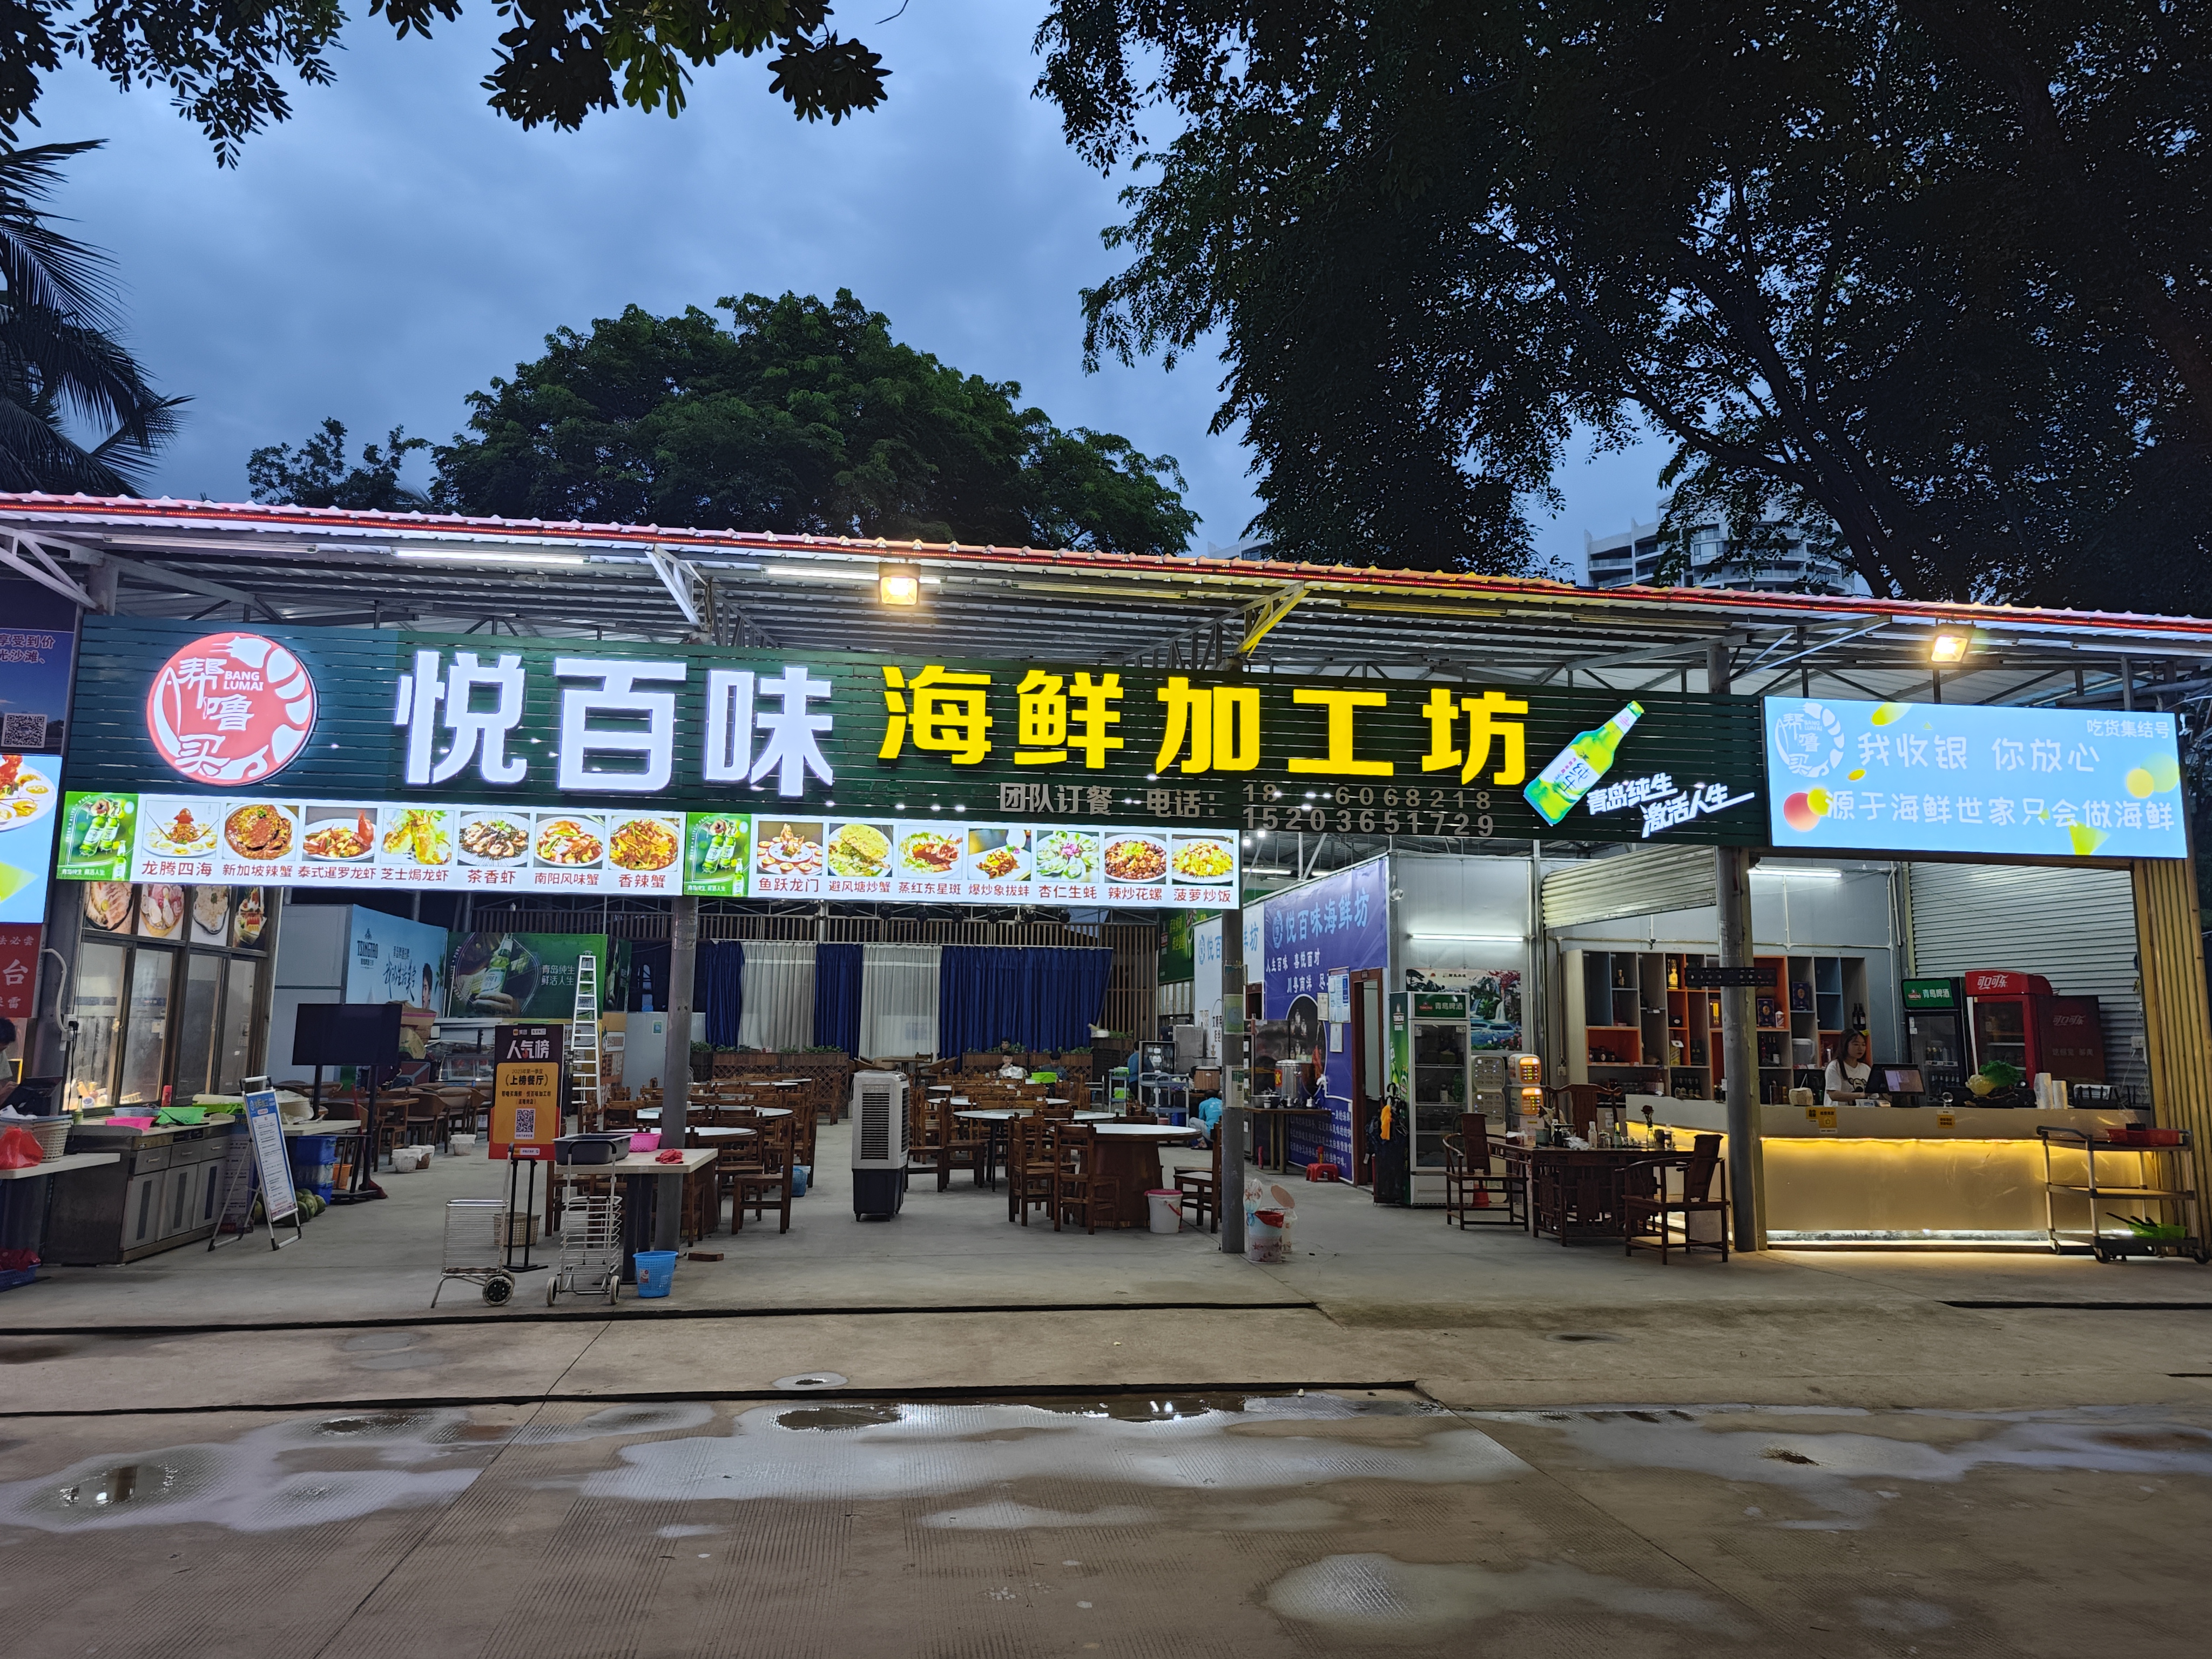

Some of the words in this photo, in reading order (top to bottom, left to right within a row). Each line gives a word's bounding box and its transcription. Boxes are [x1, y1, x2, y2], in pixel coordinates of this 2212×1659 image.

[224, 670, 260, 682] BANG
[223, 680, 264, 691] LUMAI
[394, 651, 833, 797] 悦百味
[878, 665, 1528, 786] 海鲜加工坊
[2086, 718, 2170, 739] 吃货集结号
[1856, 730, 1967, 770] 我收银
[1991, 736, 2101, 773] 你放心
[999, 783, 1114, 815] 团队订餐
[1586, 773, 1678, 816] 青岛纯生
[1639, 783, 1755, 839] 激活人生
[1825, 790, 2175, 832] 源于海鲜世家只会做海鲜
[1242, 807, 1494, 837] 15203651729
[141, 860, 213, 876] 龙腾四海
[222, 864, 293, 878] 新加坡辣蟹
[298, 865, 377, 880] 泰式暹罗龙虾
[380, 867, 449, 882] 芝士焗龙虾
[467, 868, 516, 885] 茶香虾
[535, 873, 599, 886] 南阳风味蟹
[618, 874, 666, 888] 香辣蟹
[758, 877, 819, 893] 鱼跃龙门
[828, 880, 891, 893] 避风塘炒蟹
[898, 881, 962, 895] 蒸红东星斑
[968, 884, 1030, 896] 爆炒象拔蚌
[1038, 885, 1097, 899] 杏仁生蚝
[1107, 887, 1163, 901] 辣炒花螺
[1173, 888, 1231, 903] 菠萝炒饭
[1286, 887, 1370, 944] 悦百味海鲜坊
[357, 940, 379, 959] TSINGTAO
[1266, 954, 1288, 973] 人生百味
[1293, 947, 1320, 969] 喜悦面对
[3, 959, 29, 986] 台
[542, 965, 576, 975] 青岛纯生
[541, 975, 575, 986] 鲜活人生
[1977, 974, 2008, 990] 可口可乐
[1922, 989, 1950, 999] 青岛啤酒
[1435, 1002, 1463, 1010] 青岛啤酒
[507, 1039, 550, 1060] 人气榜
[509, 1075, 544, 1085] 上榜餐厅
